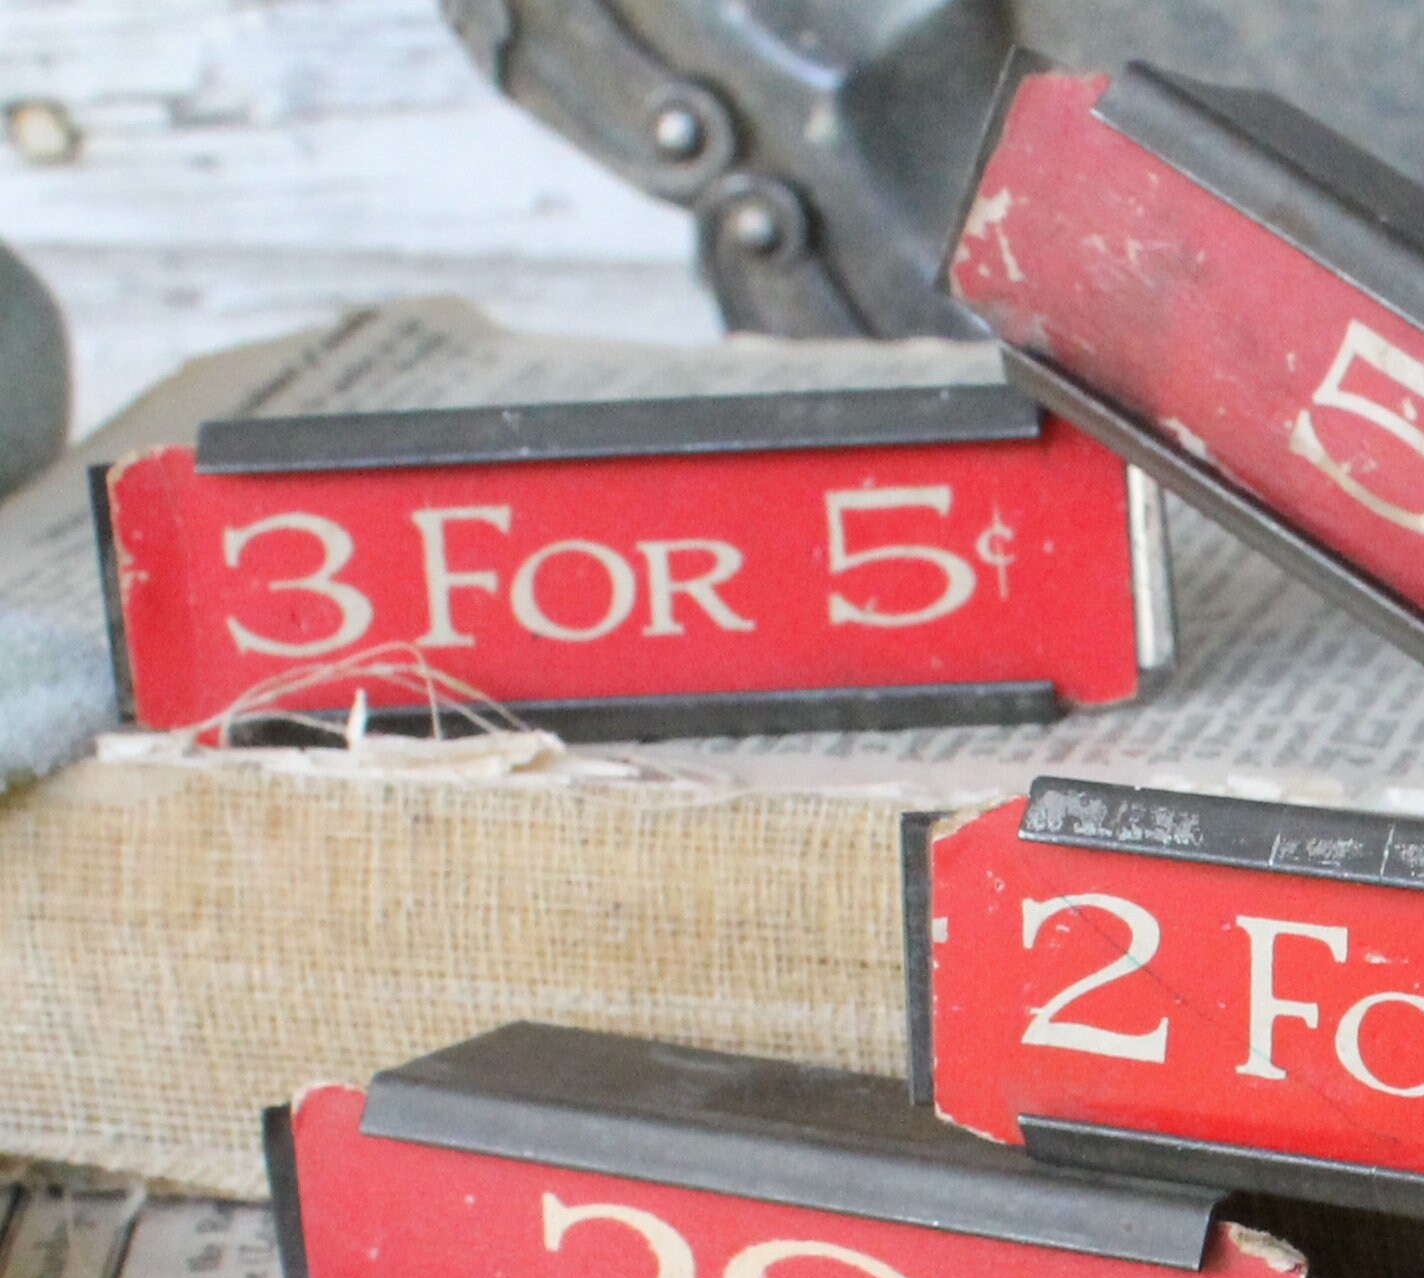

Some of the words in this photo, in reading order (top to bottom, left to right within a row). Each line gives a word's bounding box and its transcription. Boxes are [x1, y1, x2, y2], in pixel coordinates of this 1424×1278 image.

[222, 512, 374, 658] 3
[826, 484, 1014, 628] 5¢
[1020, 892, 1169, 1065] 2
